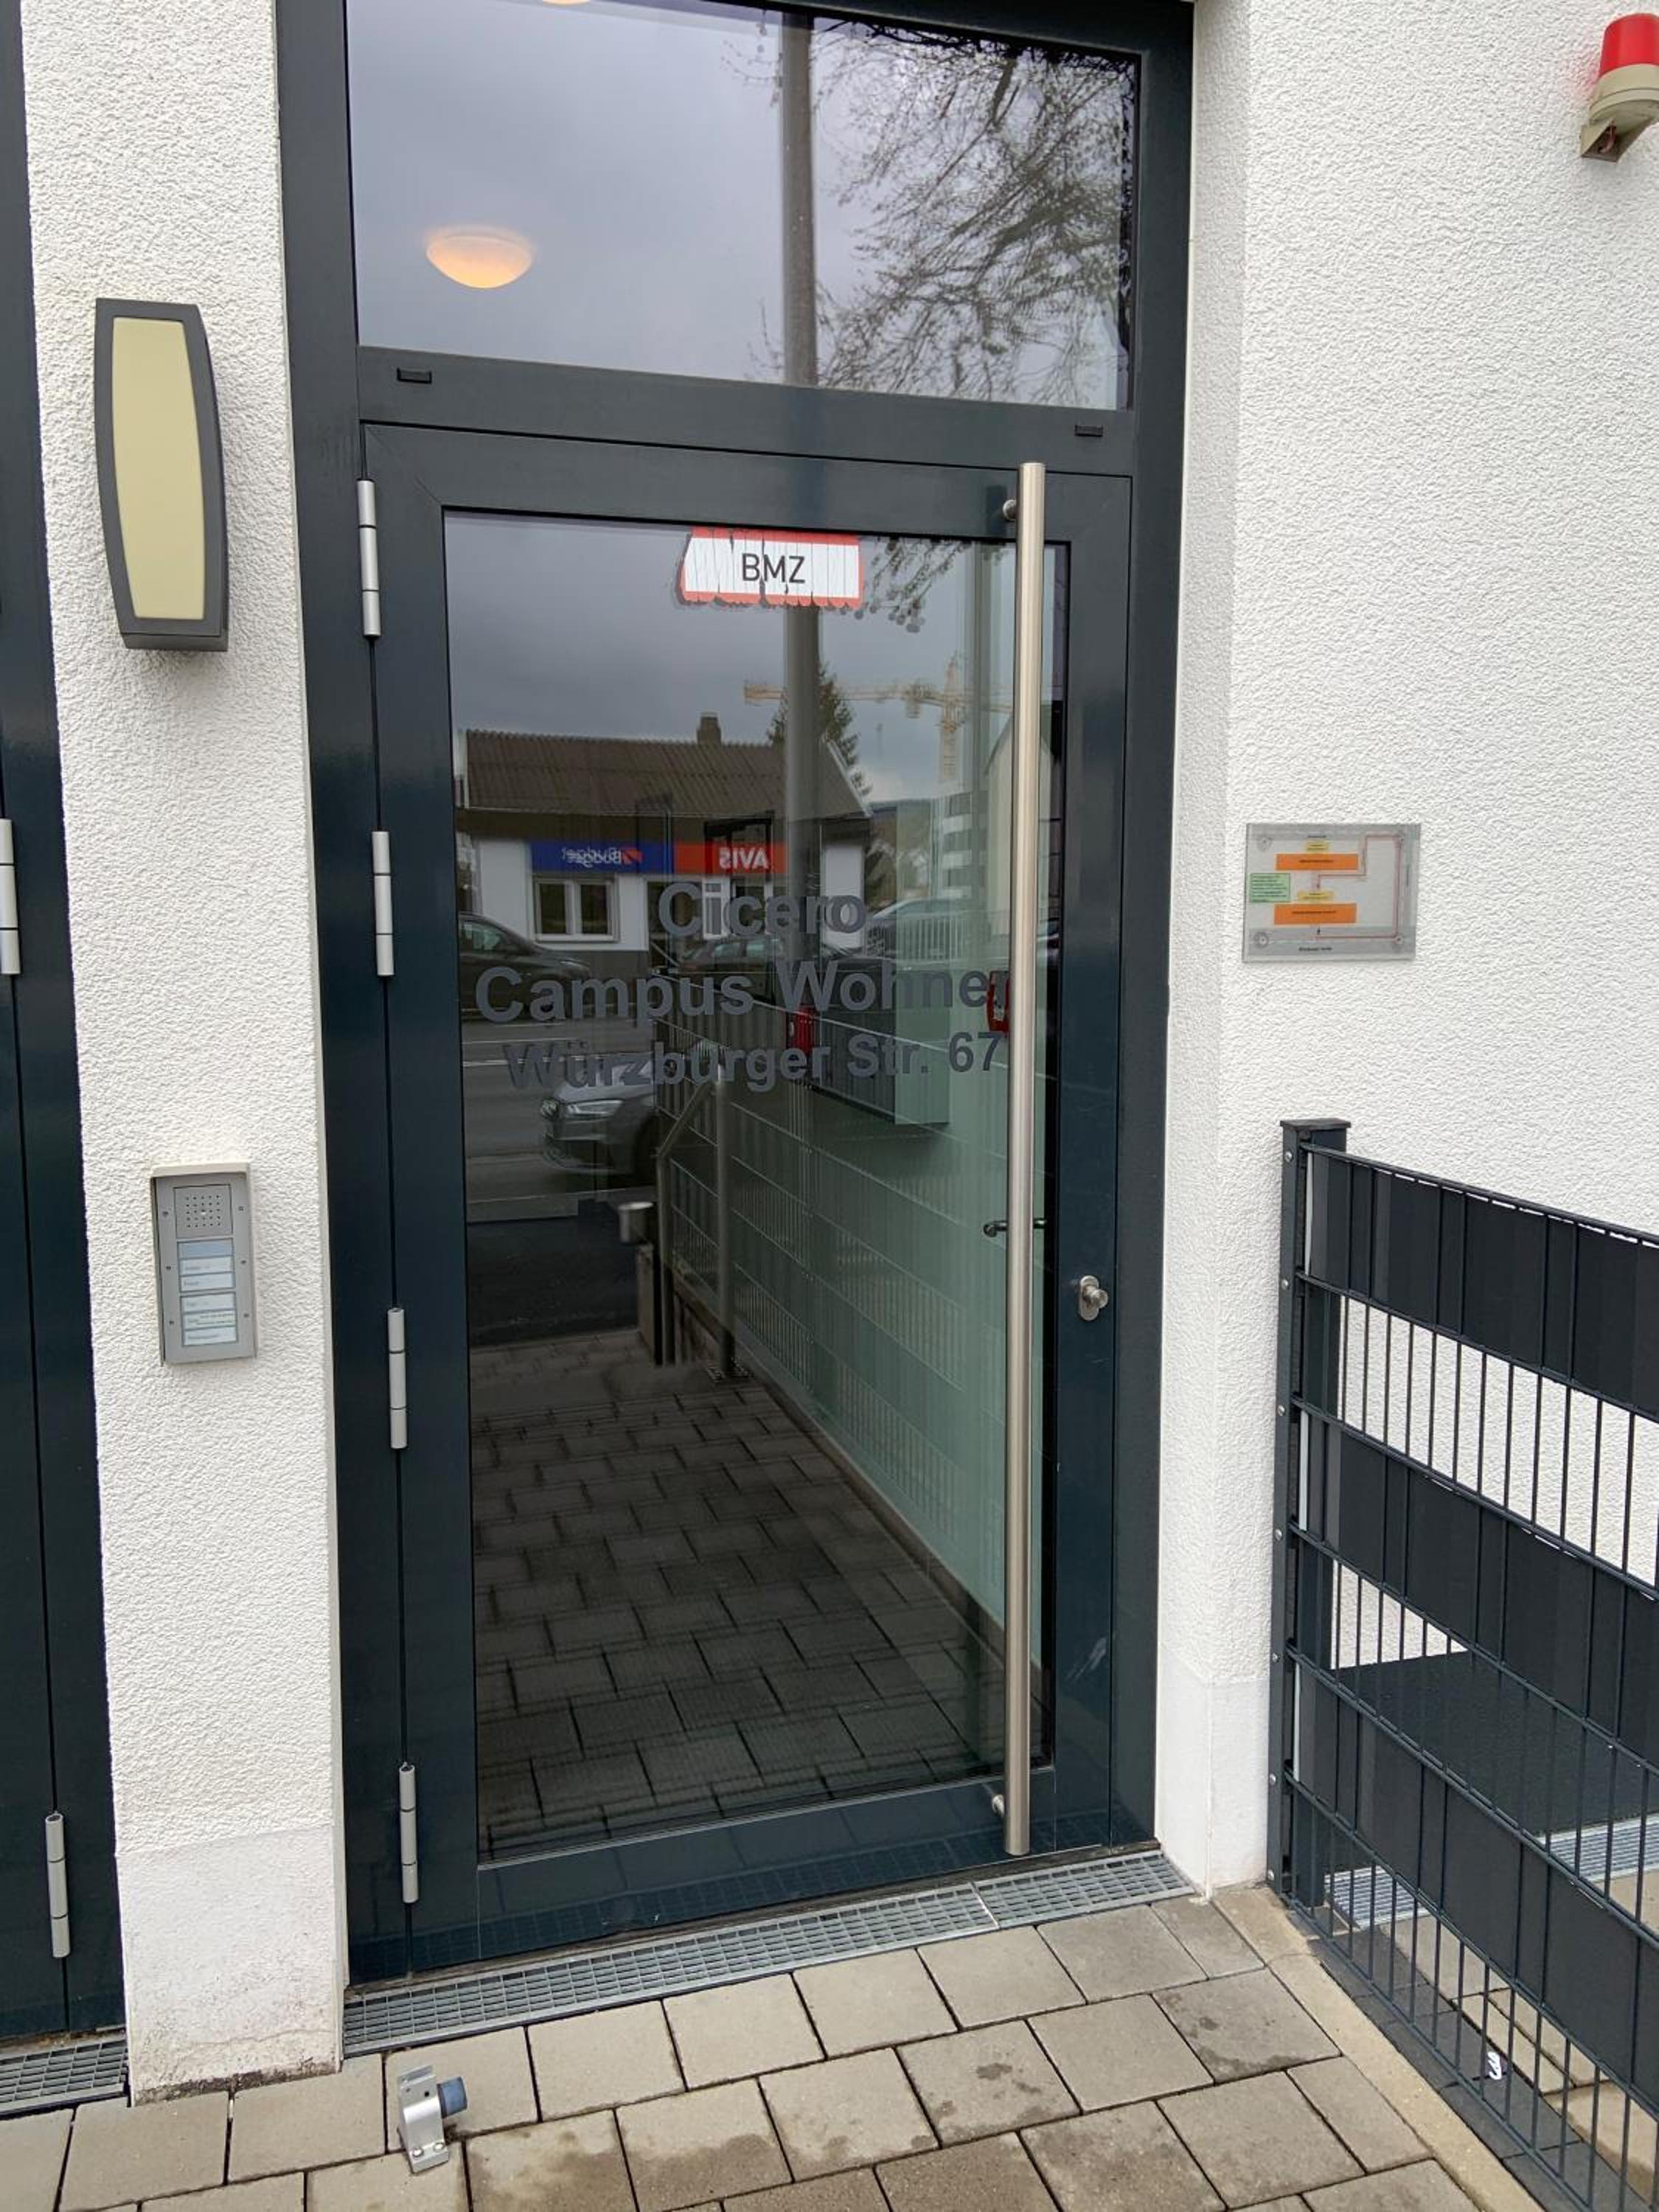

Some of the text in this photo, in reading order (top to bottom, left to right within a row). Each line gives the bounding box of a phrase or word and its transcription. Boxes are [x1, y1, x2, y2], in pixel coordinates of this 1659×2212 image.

[742, 553, 805, 584] BMZ
[658, 882, 867, 937] Cicero
[475, 965, 755, 1030] Campus
[503, 1032, 1003, 1093] Würzburger Str. 67
